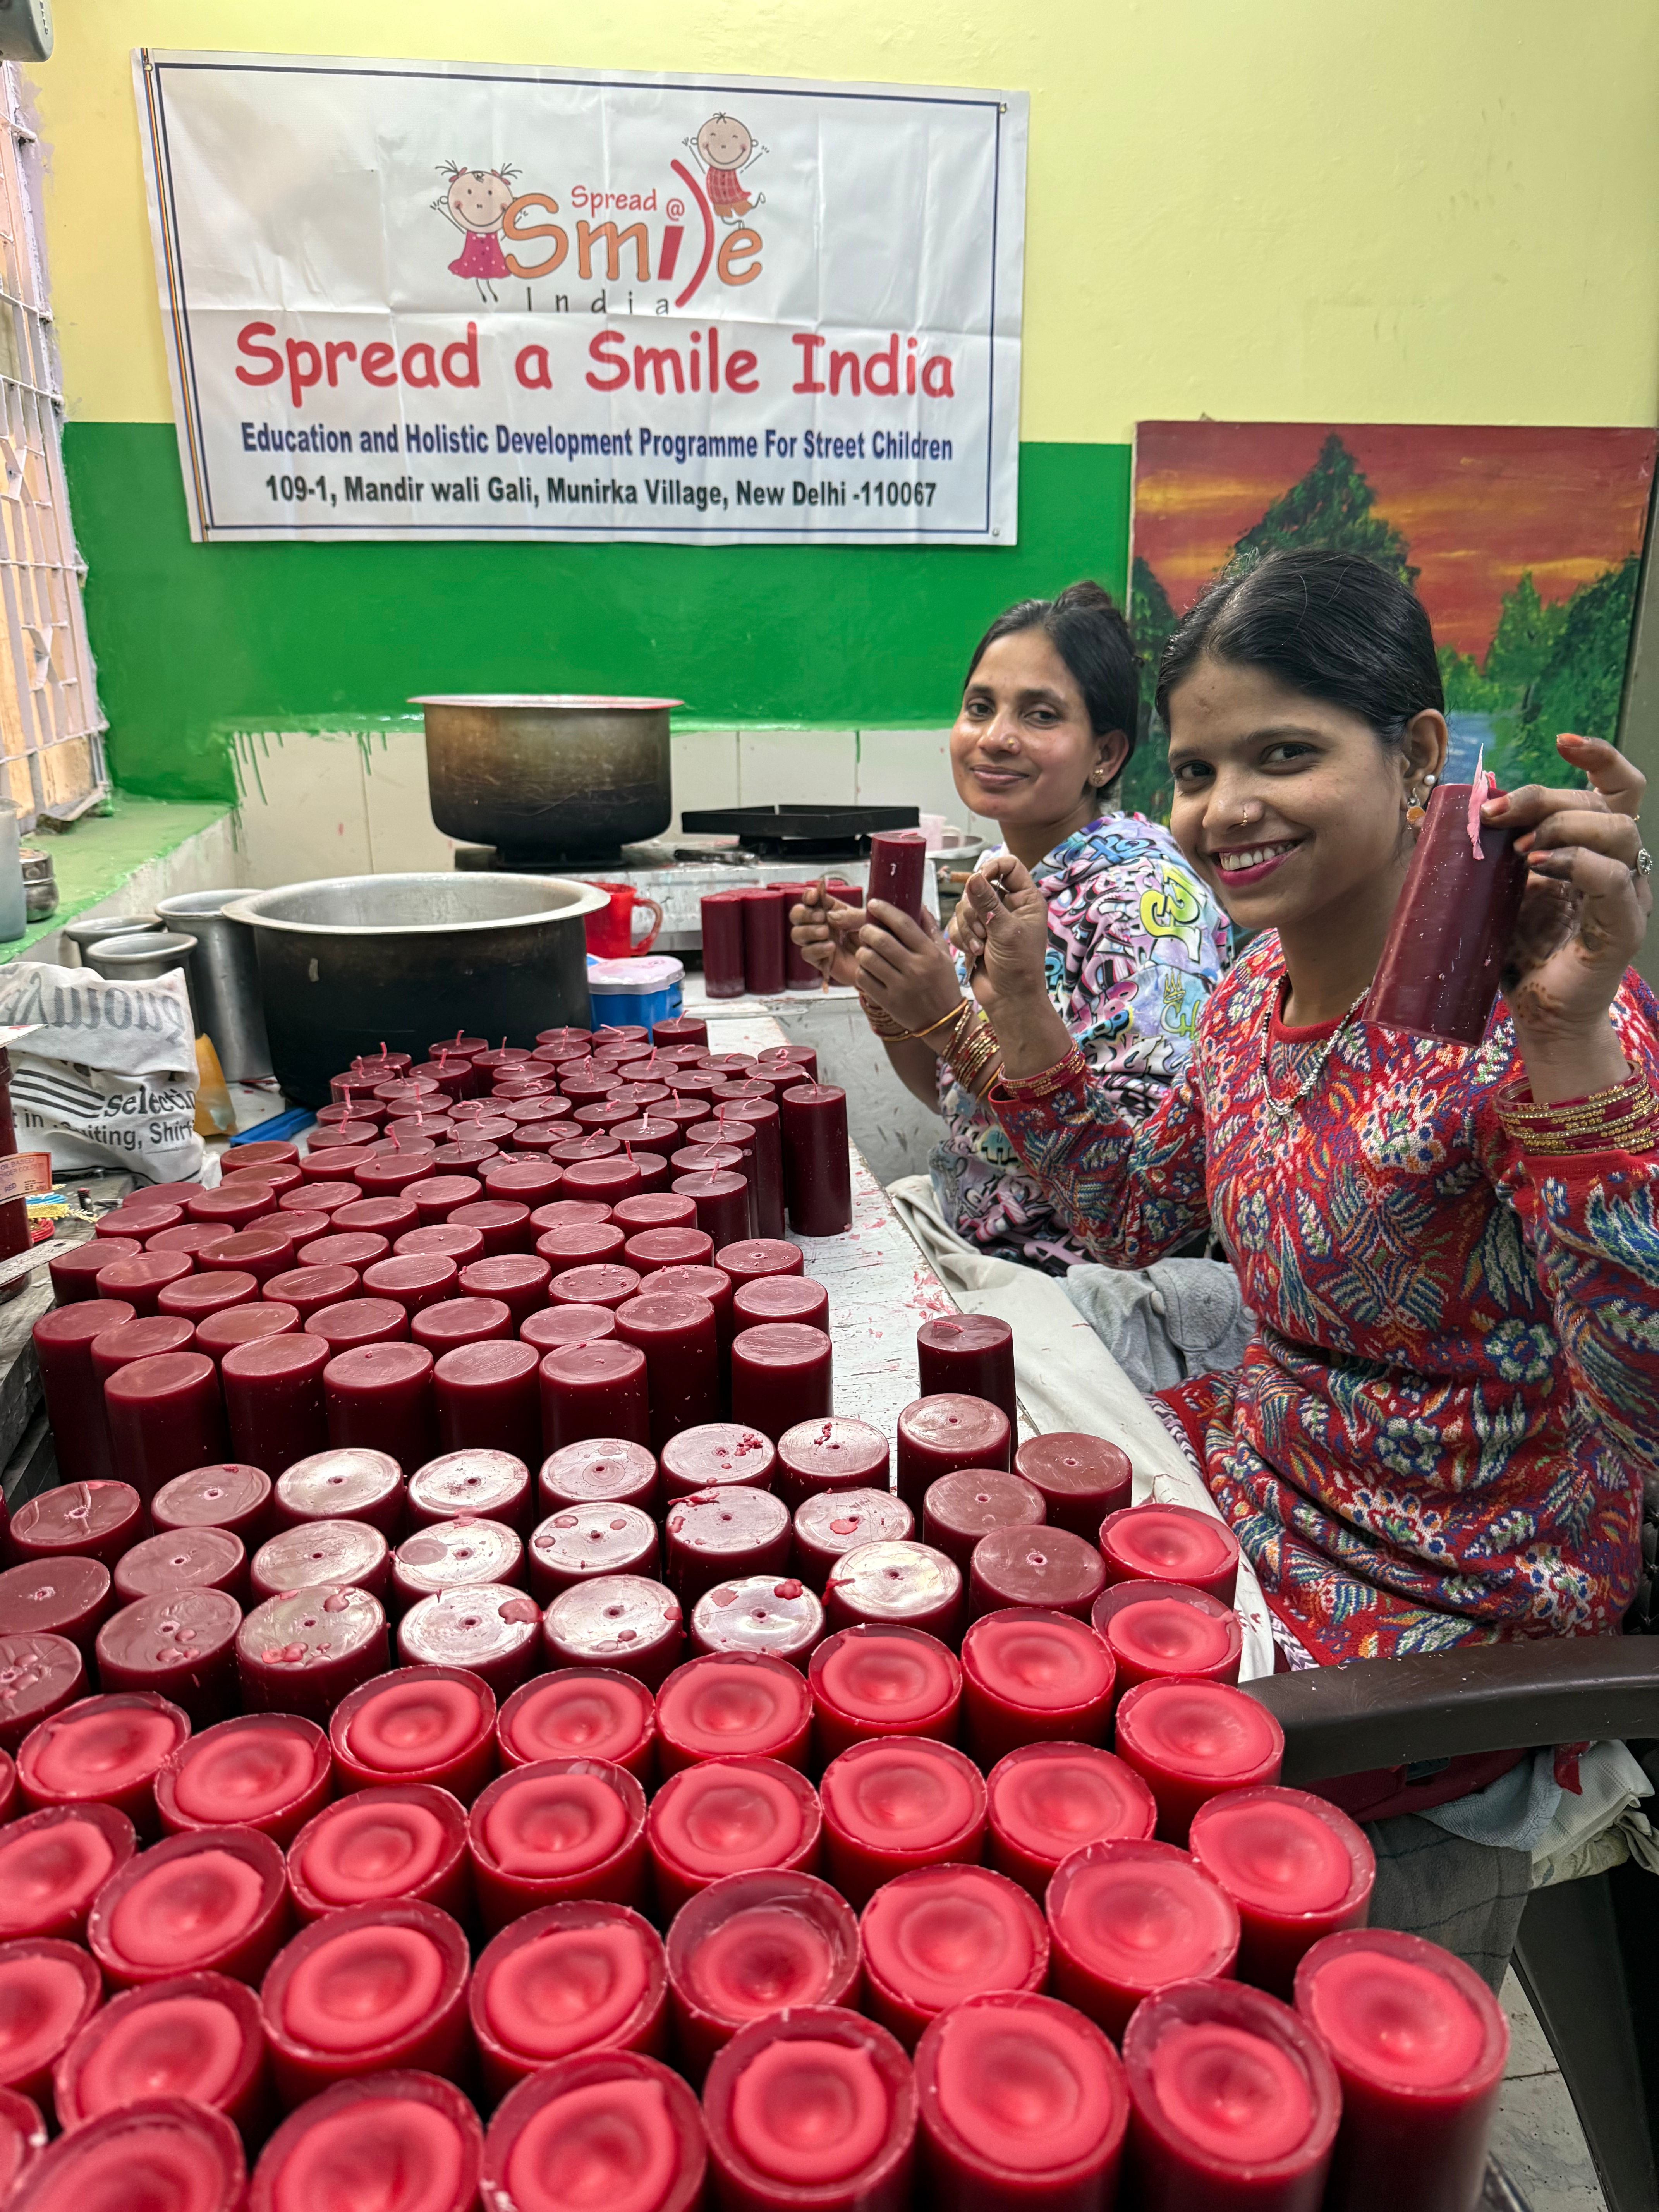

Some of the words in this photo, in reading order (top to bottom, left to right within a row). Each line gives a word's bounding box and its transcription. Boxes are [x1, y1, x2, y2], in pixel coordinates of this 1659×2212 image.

[572, 186, 656, 217] Spread
[527, 287, 668, 314] India
[235, 321, 480, 408] Spread
[515, 345, 552, 389] a
[586, 327, 759, 395] Smile
[792, 333, 954, 398] India
[242, 422, 352, 452] Education
[360, 424, 398, 452] and
[406, 424, 488, 453] Holistic
[496, 425, 632, 461] Development
[640, 428, 757, 463] Programme
[766, 429, 797, 457] For
[804, 430, 864, 458] Street
[873, 431, 952, 459] Children
[266, 475, 336, 507] 109-1,
[345, 476, 424, 501] Mandir
[431, 477, 479, 501] wali
[488, 477, 538, 507] Gali,
[548, 477, 637, 503] Munirka
[645, 479, 727, 511] Village,
[737, 481, 784, 505] New
[793, 481, 845, 505] Delhi
[853, 481, 936, 506] -110067
[149, 1120, 195, 1144] Shirt
[11, 1158, 34, 1167] BASED
